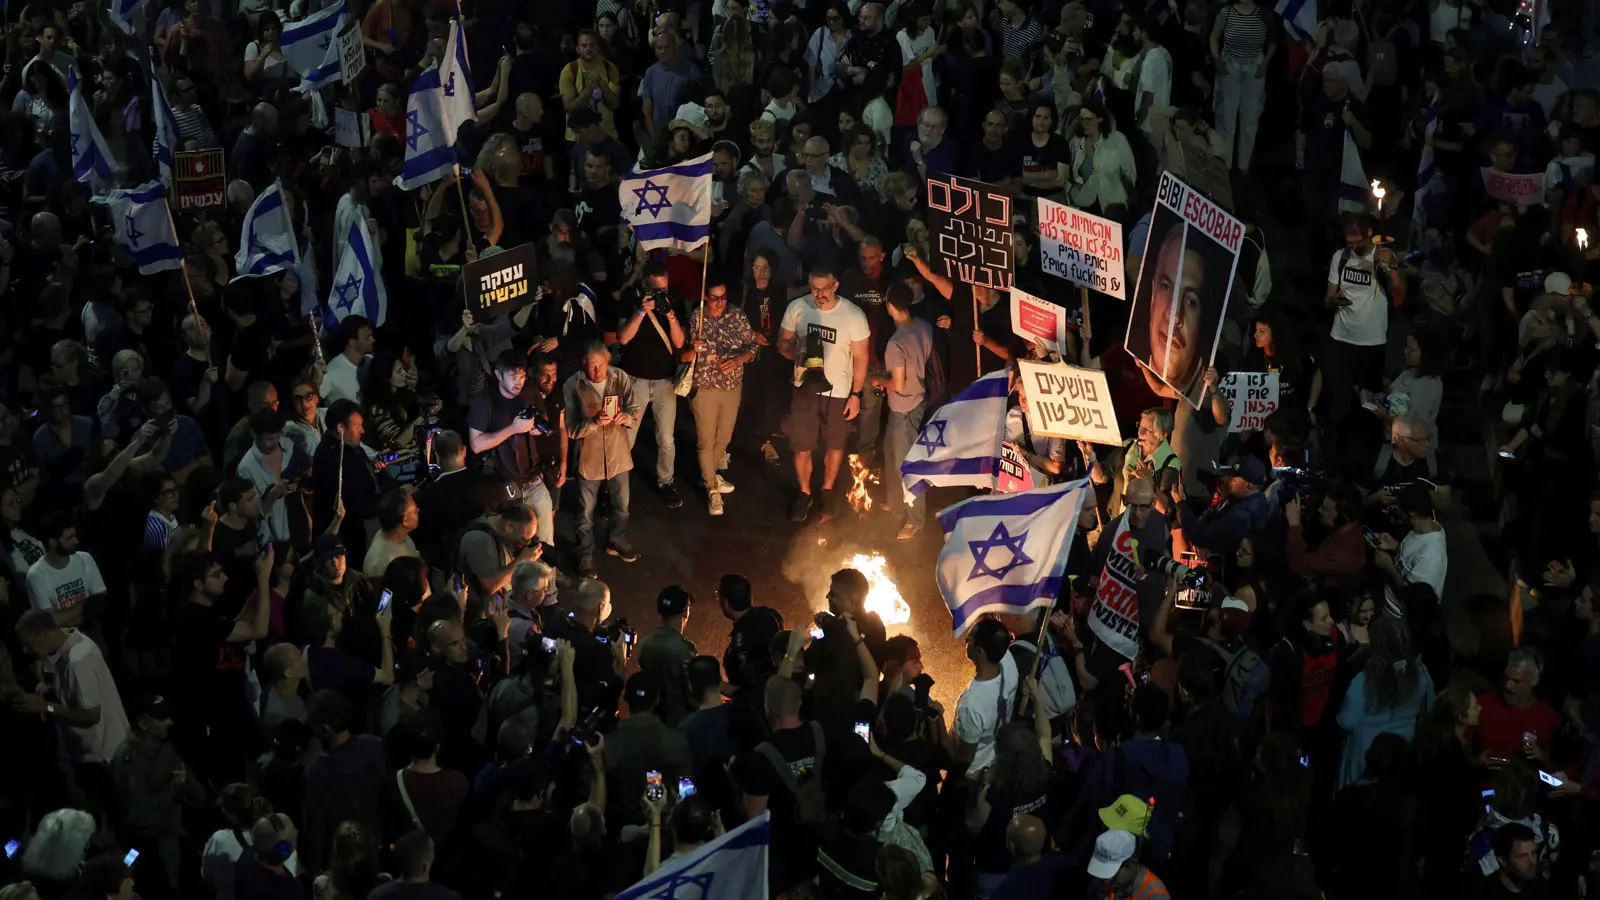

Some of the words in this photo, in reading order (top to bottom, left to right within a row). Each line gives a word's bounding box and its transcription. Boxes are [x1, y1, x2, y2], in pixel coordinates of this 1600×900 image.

[928, 177, 1009, 227] כולם
[1046, 205, 1068, 226] שלנו
[1159, 174, 1185, 211] BIBI
[1184, 192, 1241, 251] ESCOBAR
[944, 218, 1013, 247] תמורת
[1086, 238, 1098, 254] לא
[939, 233, 1008, 269] כולם
[1059, 244, 1080, 262] רבים
[1084, 253, 1108, 272] ואתם
[480, 262, 524, 291] עסקה
[943, 257, 1013, 293] עכשיו
[1071, 263, 1107, 291] fucking
[1111, 277, 1121, 291] על
[479, 279, 528, 309] עכשיו!
[1034, 372, 1098, 402] פושעים
[1247, 373, 1269, 387] לא
[1247, 388, 1270, 400] שום
[1036, 397, 1108, 430] בשלטון
